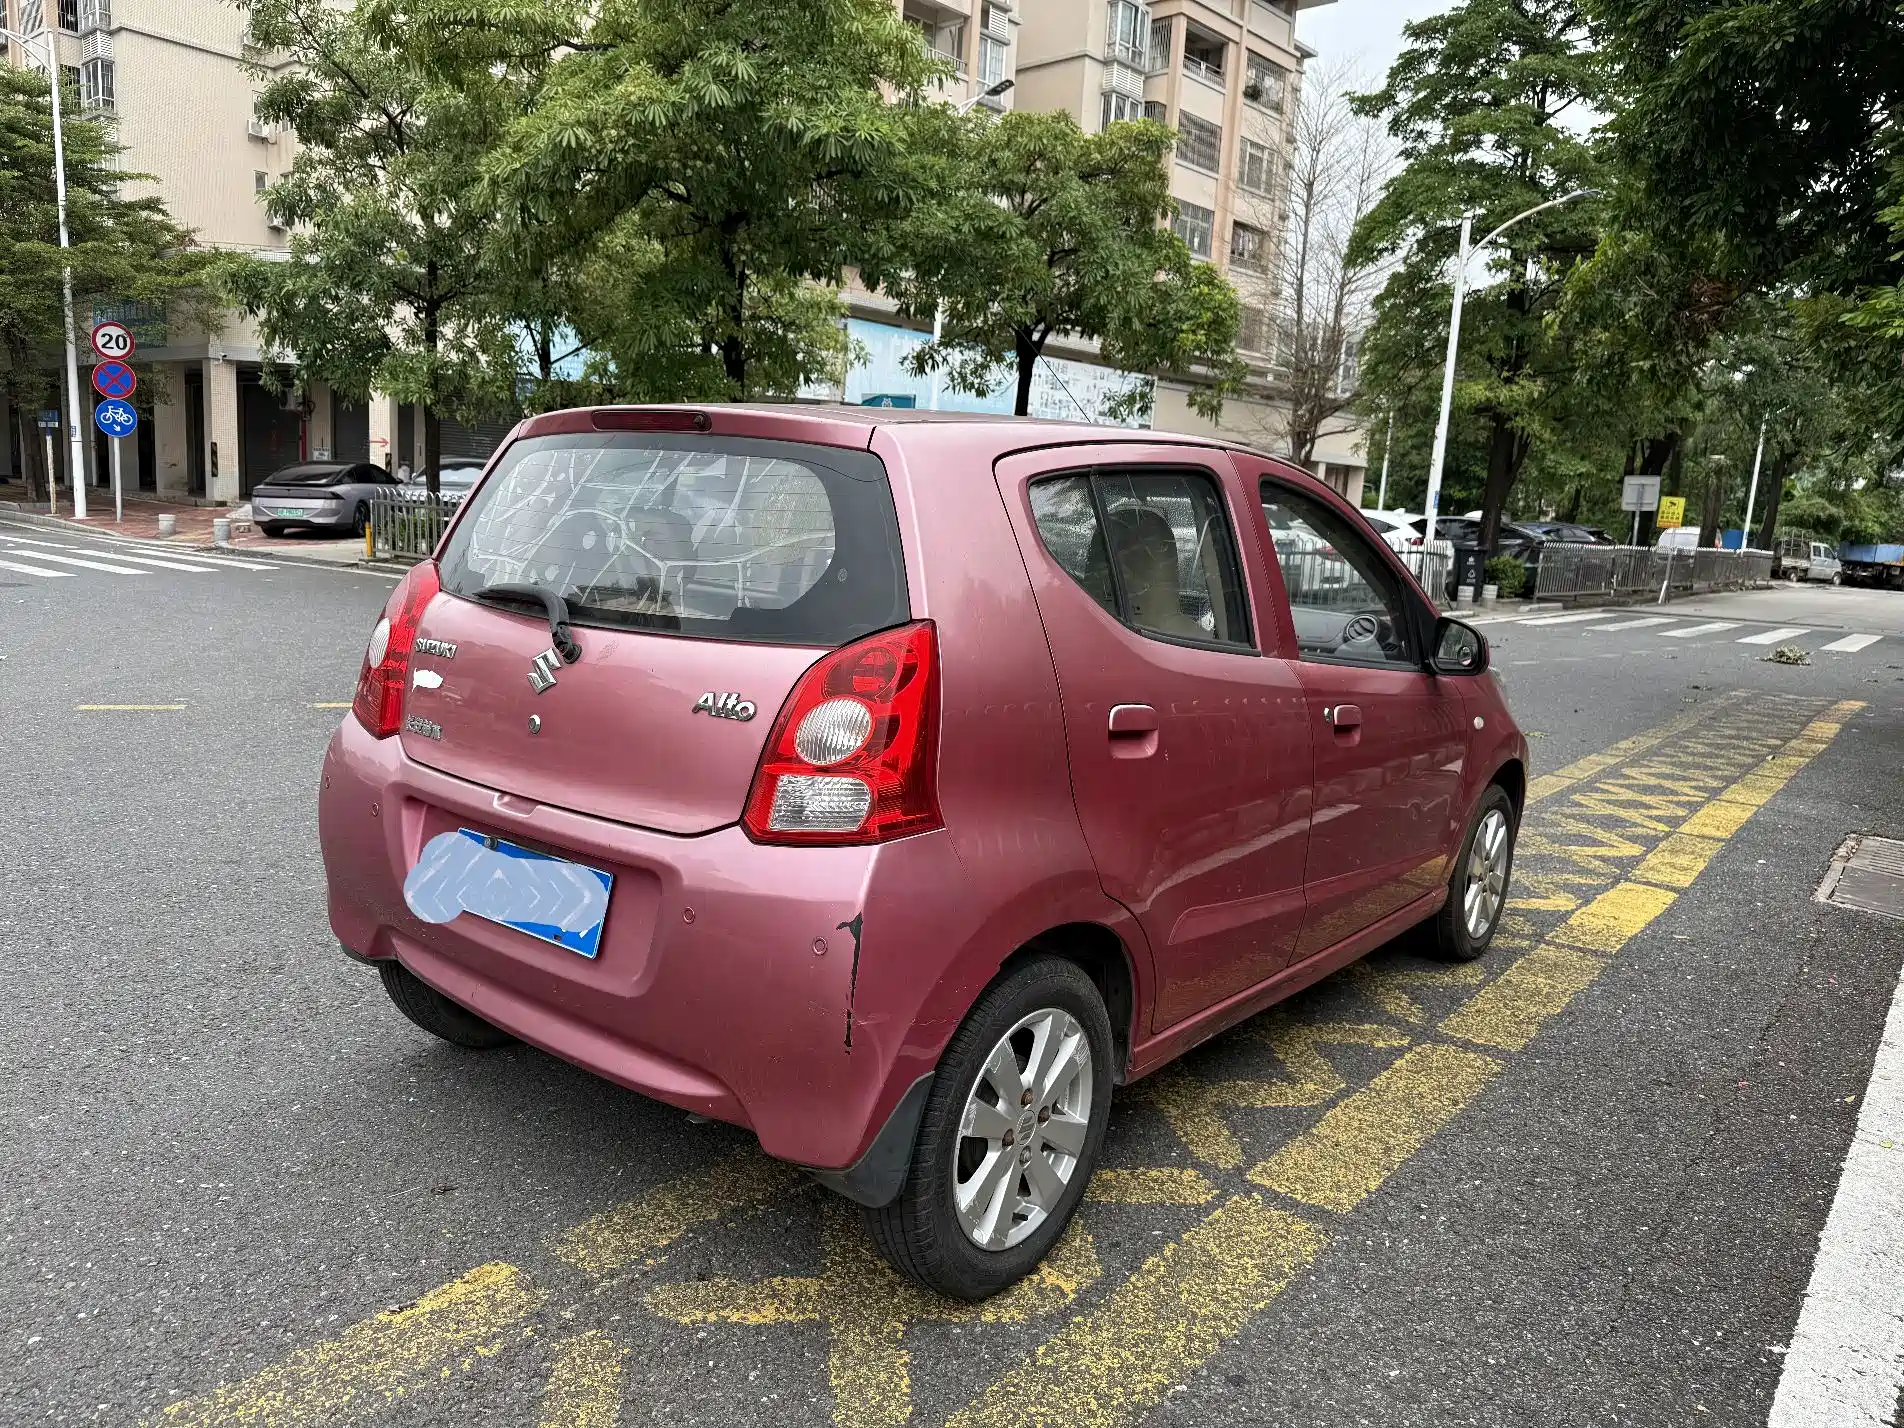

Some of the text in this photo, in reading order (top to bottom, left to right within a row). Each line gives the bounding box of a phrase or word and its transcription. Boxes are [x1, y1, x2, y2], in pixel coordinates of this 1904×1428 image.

[100, 332, 128, 350] 20
[415, 638, 458, 659] SUZUKI
[692, 691, 757, 722] Alto
